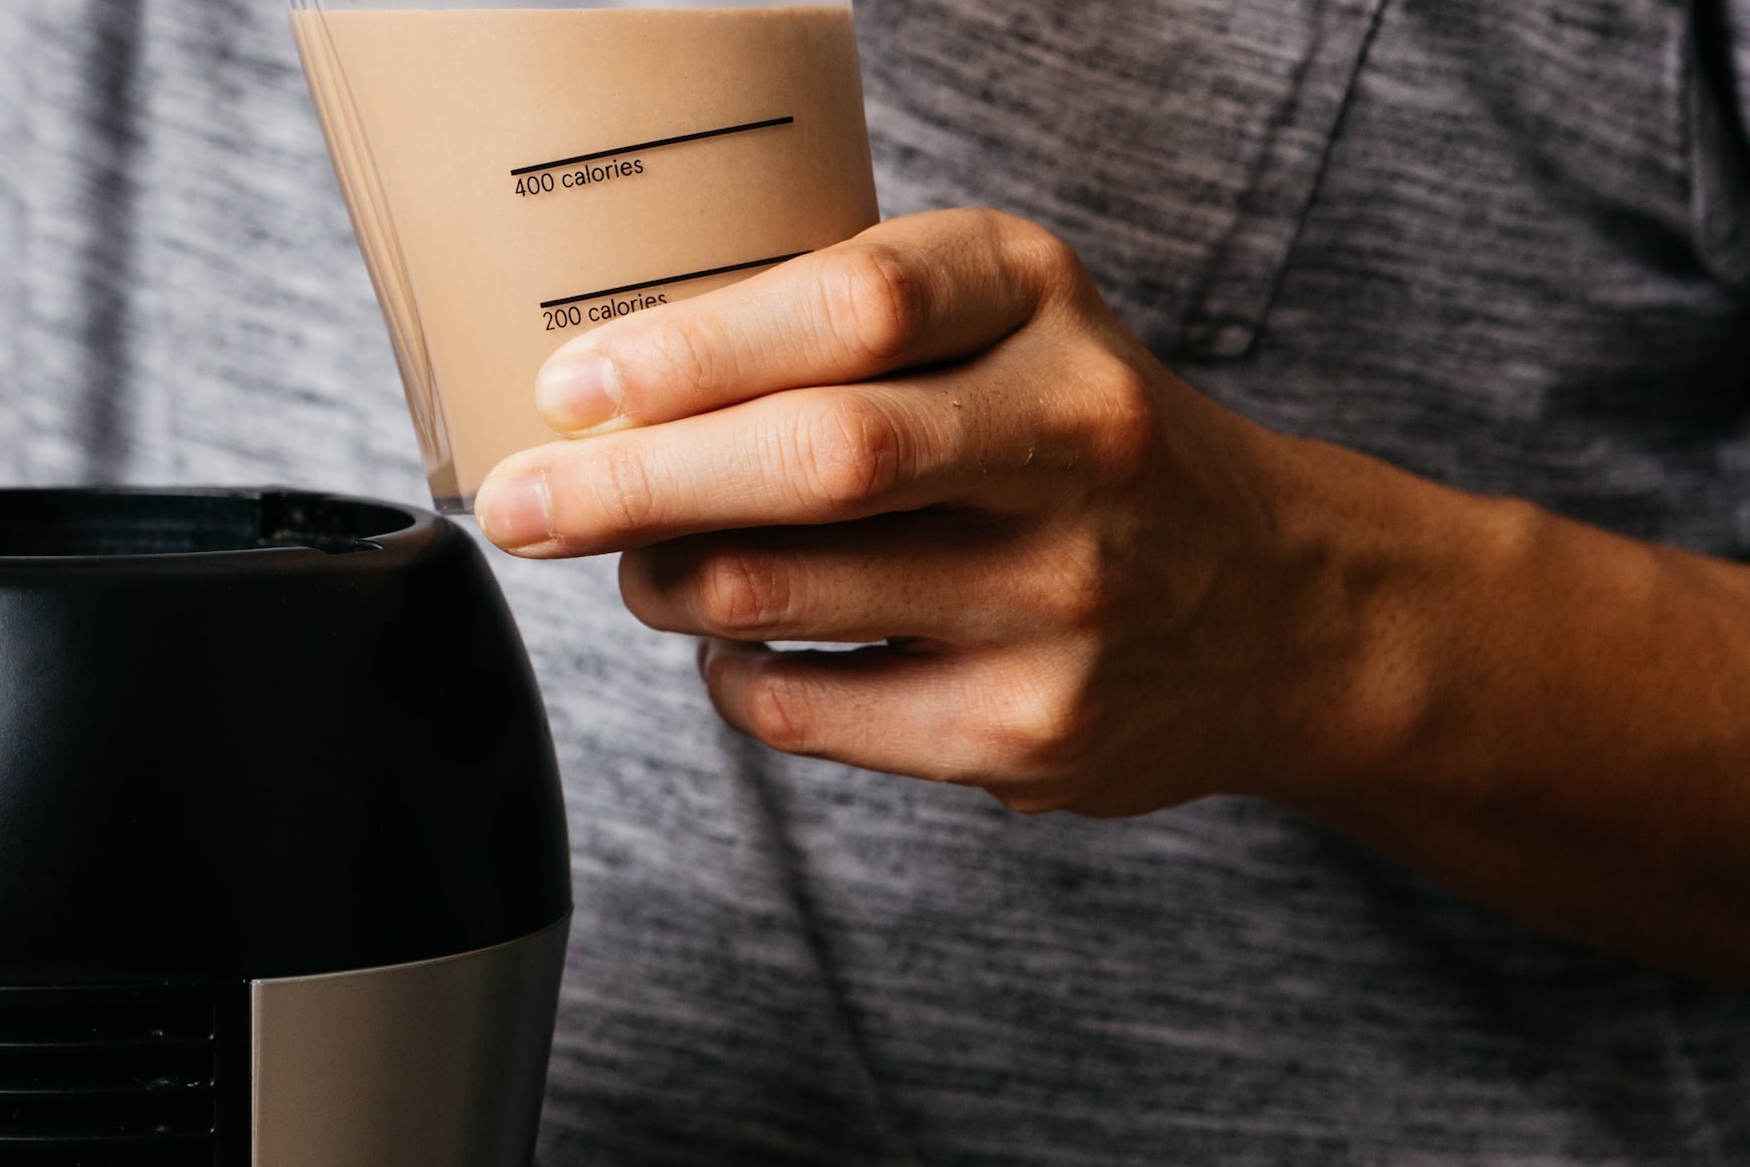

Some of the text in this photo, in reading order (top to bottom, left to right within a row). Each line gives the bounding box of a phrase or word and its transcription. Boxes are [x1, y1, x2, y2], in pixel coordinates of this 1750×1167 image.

[514, 157, 644, 197] 400 calories
[542, 306, 582, 331] 200
